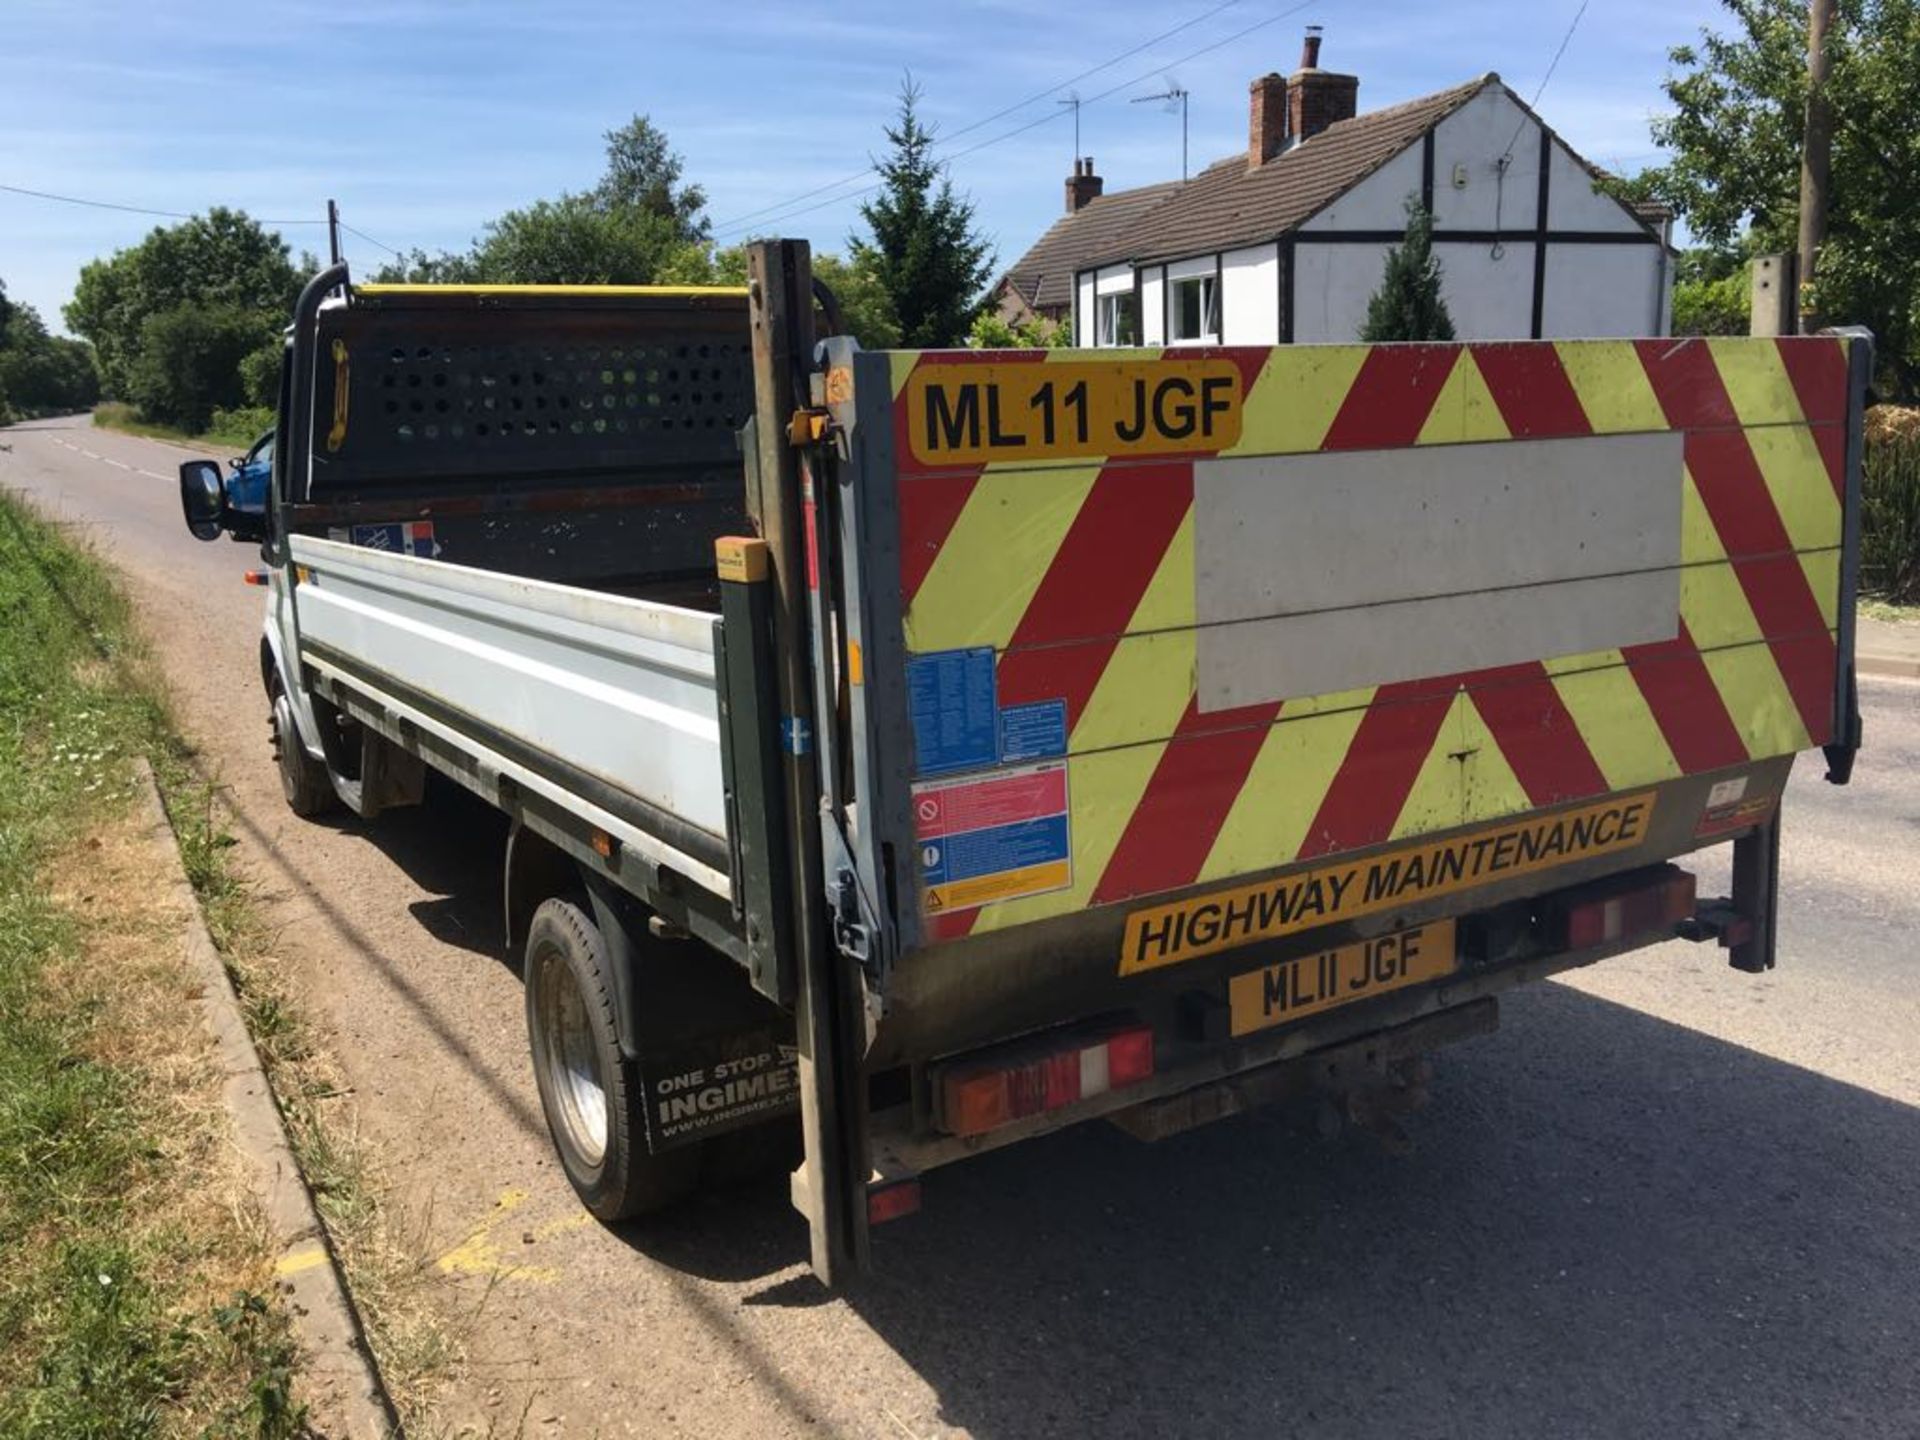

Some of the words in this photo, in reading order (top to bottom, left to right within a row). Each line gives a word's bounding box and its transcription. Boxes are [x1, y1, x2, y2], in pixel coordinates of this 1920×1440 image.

[924, 380, 1089, 451] ML11
[1114, 376, 1234, 443] JGF
[1136, 870, 1357, 961] HIGHWAY
[1363, 803, 1645, 904] MAINTENANCE
[1262, 952, 1338, 1017] ML11
[1349, 929, 1423, 990] JGF
[657, 1069, 705, 1095] ONE
[714, 1052, 772, 1079] STOP
